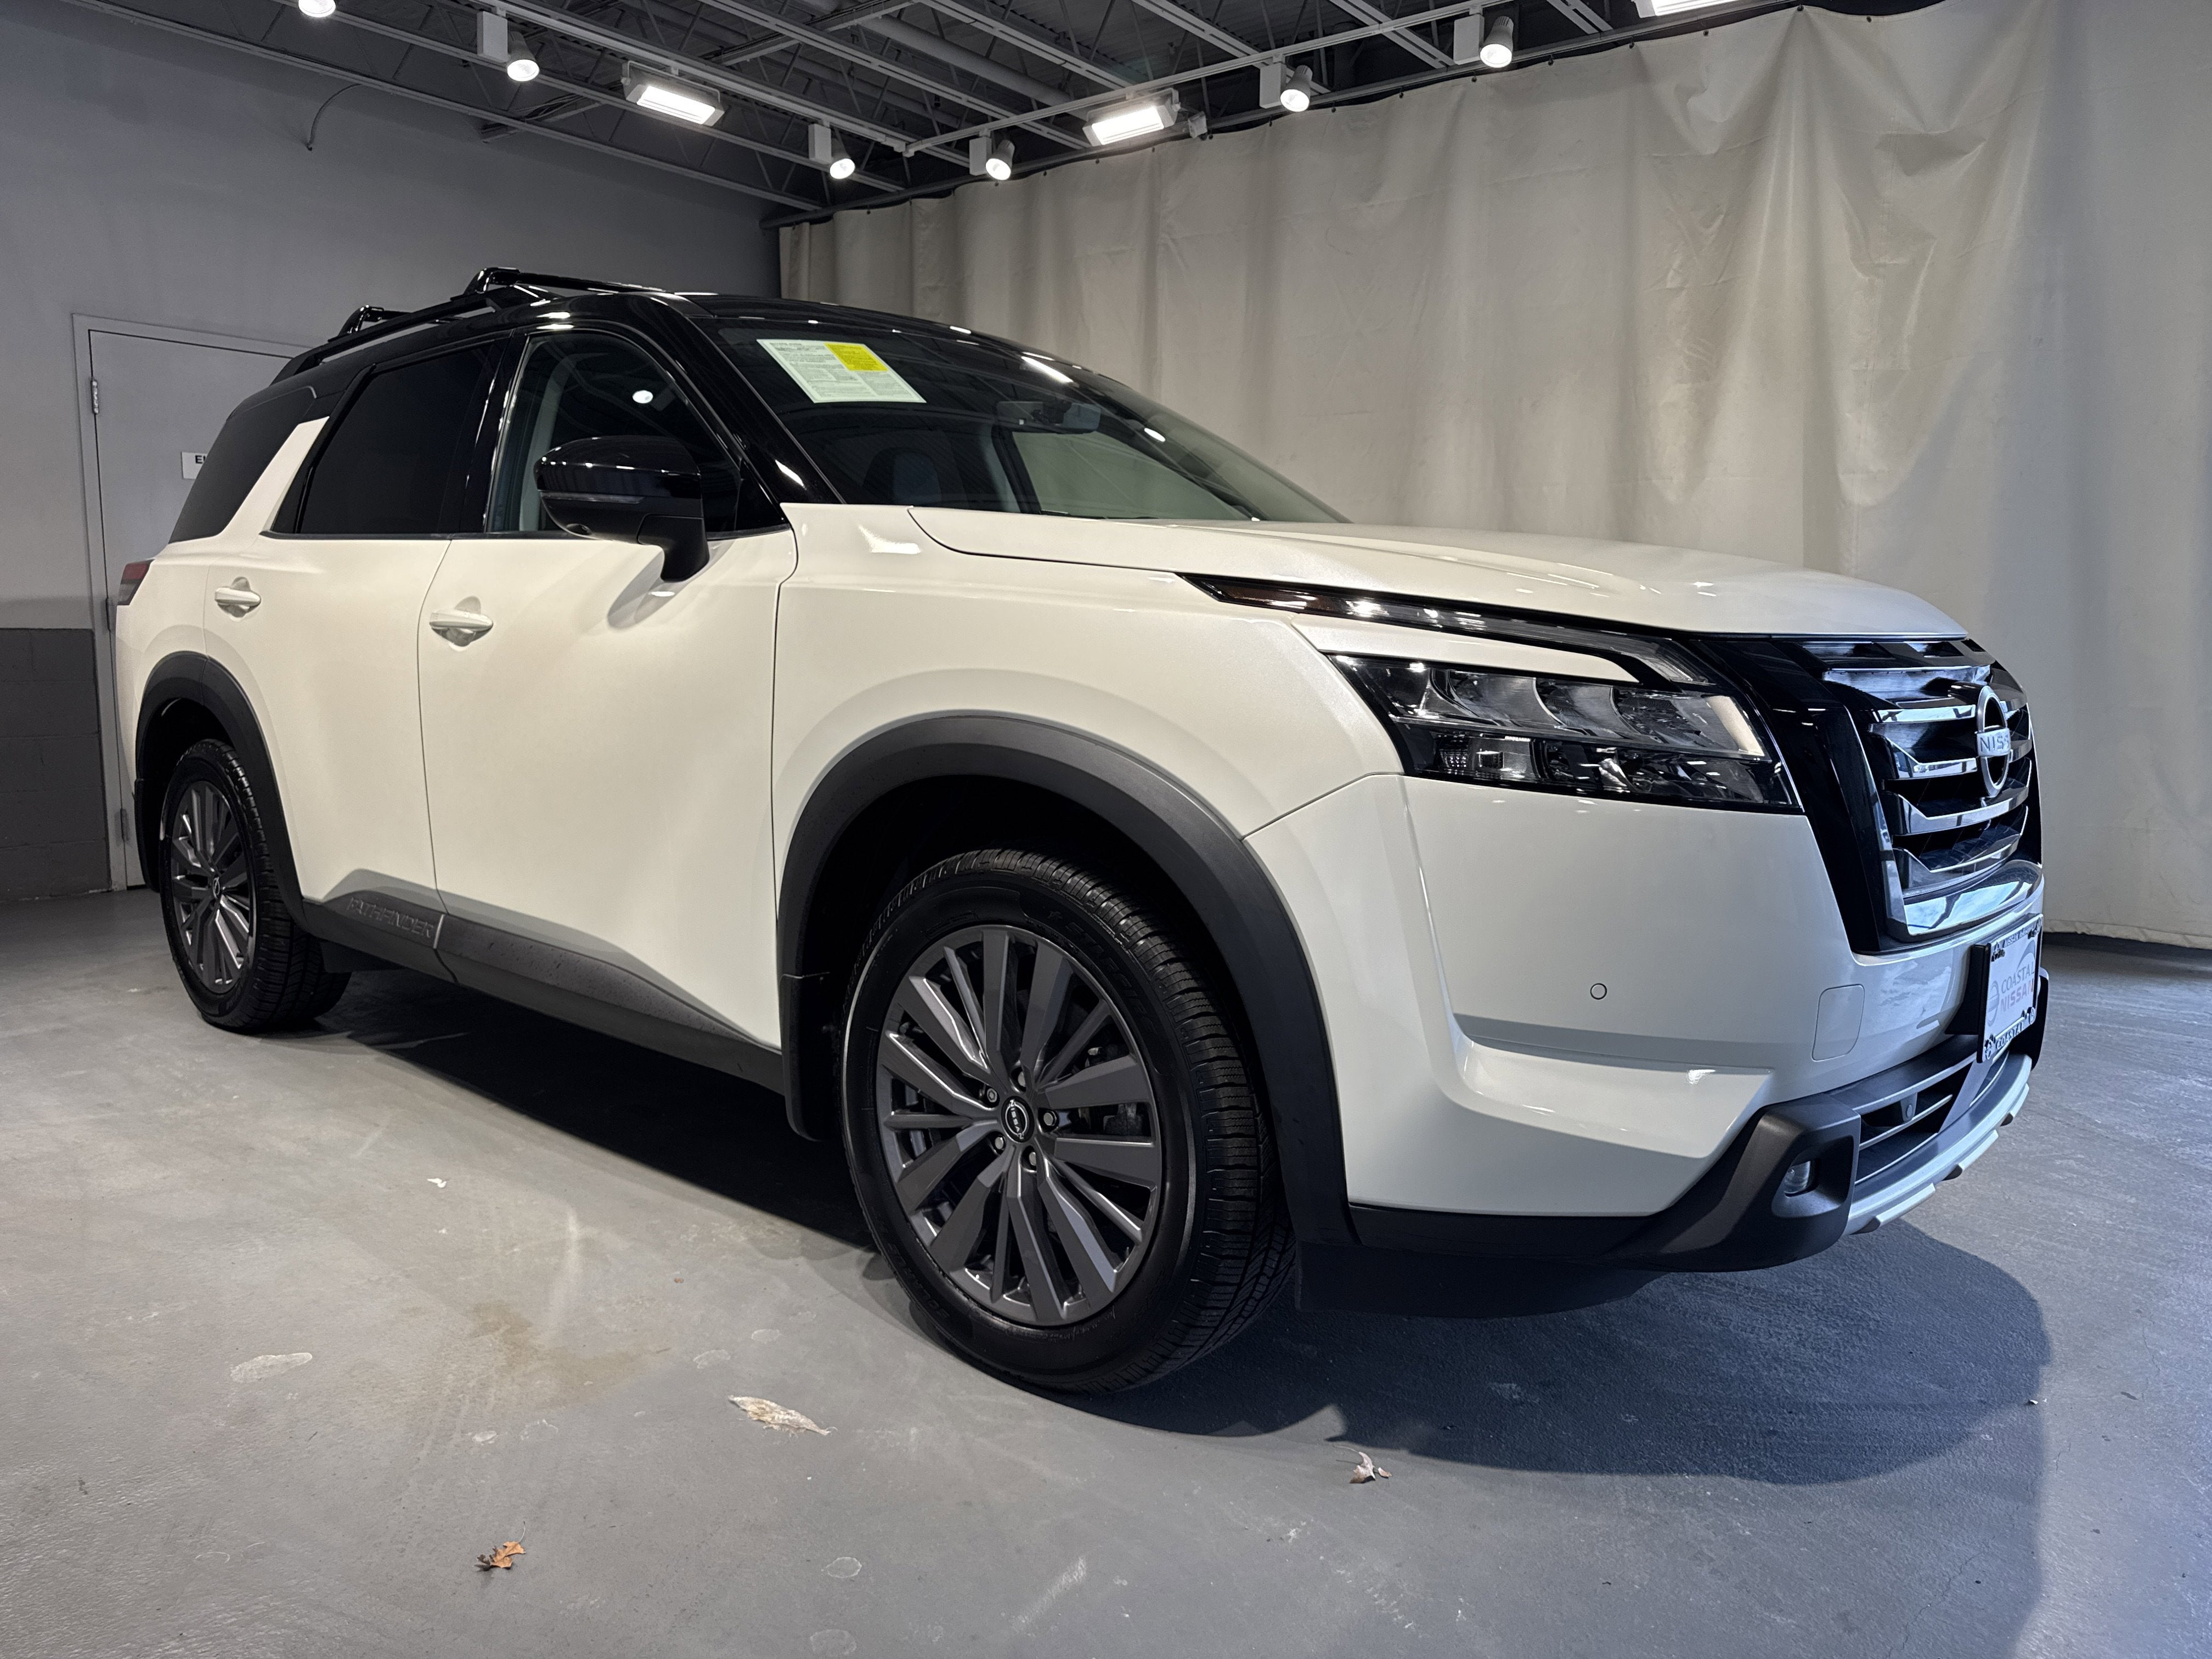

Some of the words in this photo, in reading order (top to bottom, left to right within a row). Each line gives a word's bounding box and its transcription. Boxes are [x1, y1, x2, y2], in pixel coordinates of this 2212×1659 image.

[2001, 961, 2035, 994] COASTAL
[2001, 978, 2034, 1012] NISSAN
[1996, 1022, 2024, 1050] COASTAL
[1009, 1099, 1024, 1139] NISSAN
